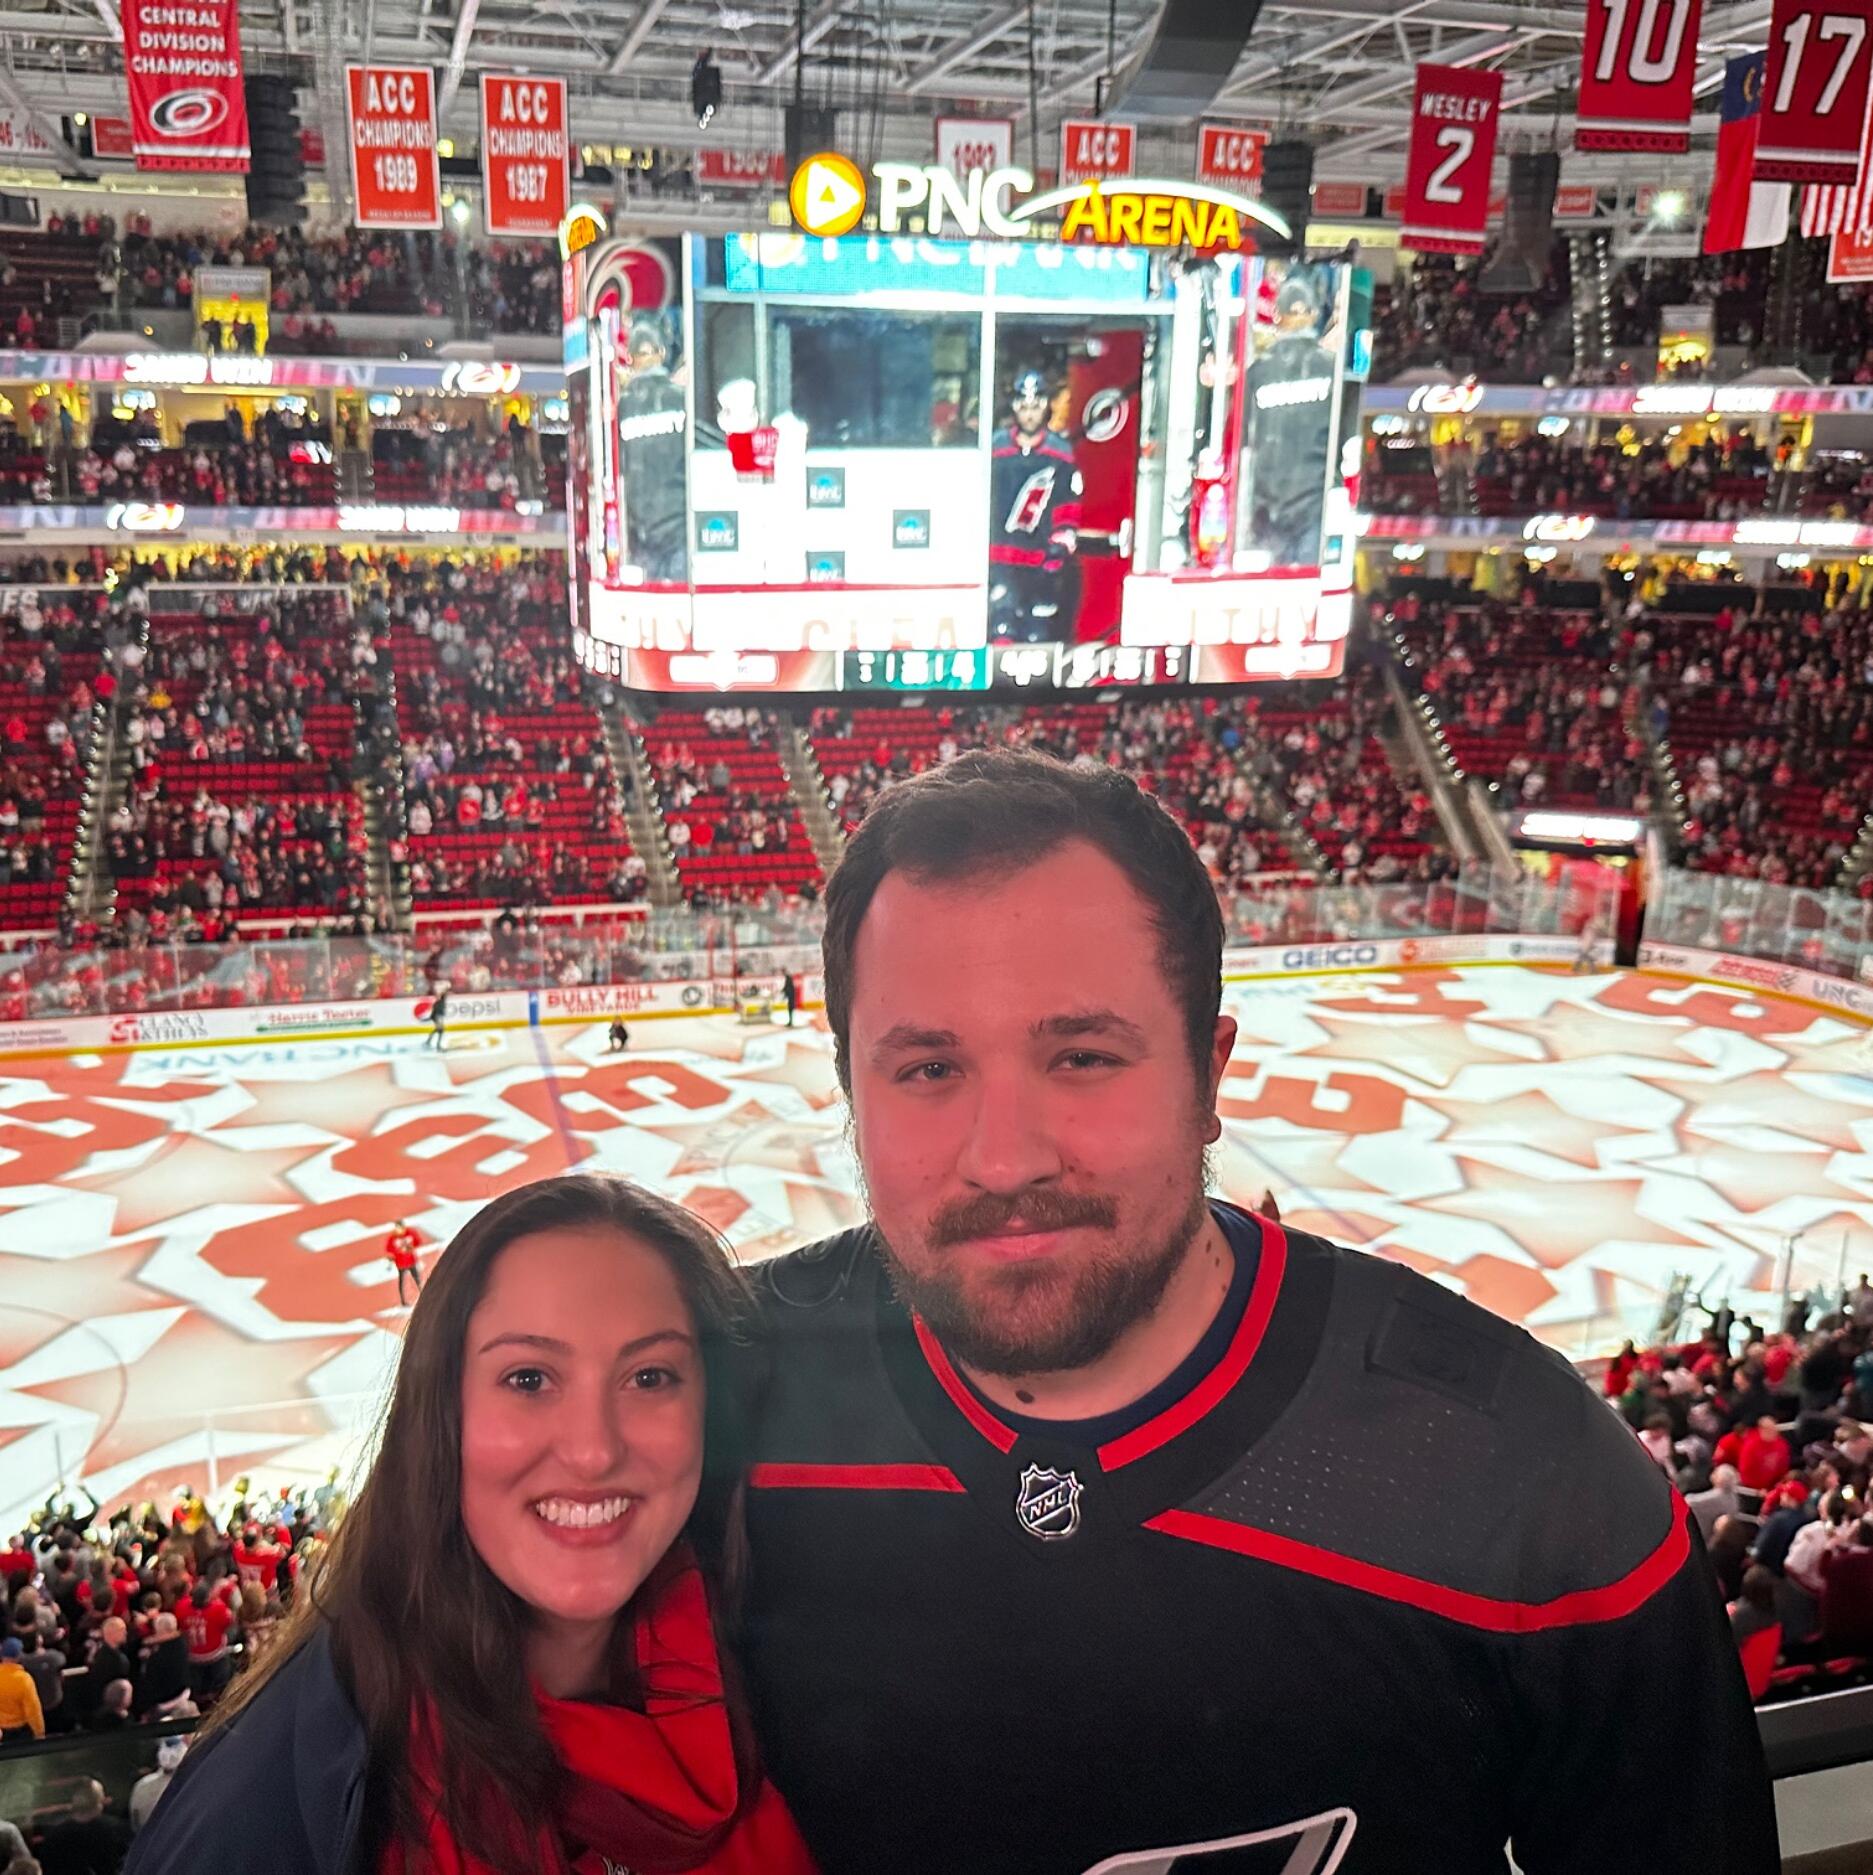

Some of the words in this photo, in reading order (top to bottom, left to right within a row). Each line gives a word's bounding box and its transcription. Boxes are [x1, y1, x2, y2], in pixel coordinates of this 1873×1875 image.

[140, 6, 221, 28] CENTRAL
[140, 31, 226, 53] DIVISION
[1595, 0, 1690, 83] 10
[132, 54, 239, 78] CHAMPIONS
[1773, 12, 1867, 115] 17
[366, 73, 416, 115] ACC
[500, 83, 549, 124] ACC
[1420, 91, 1493, 123] WESLEY
[355, 118, 435, 150] CHAMPIONS
[489, 126, 564, 160] CHAMPIONS
[1076, 129, 1120, 167] ACC
[1211, 134, 1256, 173] ACC
[1424, 126, 1475, 204] 2
[871, 161, 1035, 238] PNC
[1059, 177, 1242, 250] ARENA
[1282, 944, 1378, 969] GEICO
[447, 998, 501, 1020] pepsi
[547, 988, 611, 1009] BULLY
[615, 984, 659, 1003] HILL
[1029, 1490, 1068, 1521] NHL
